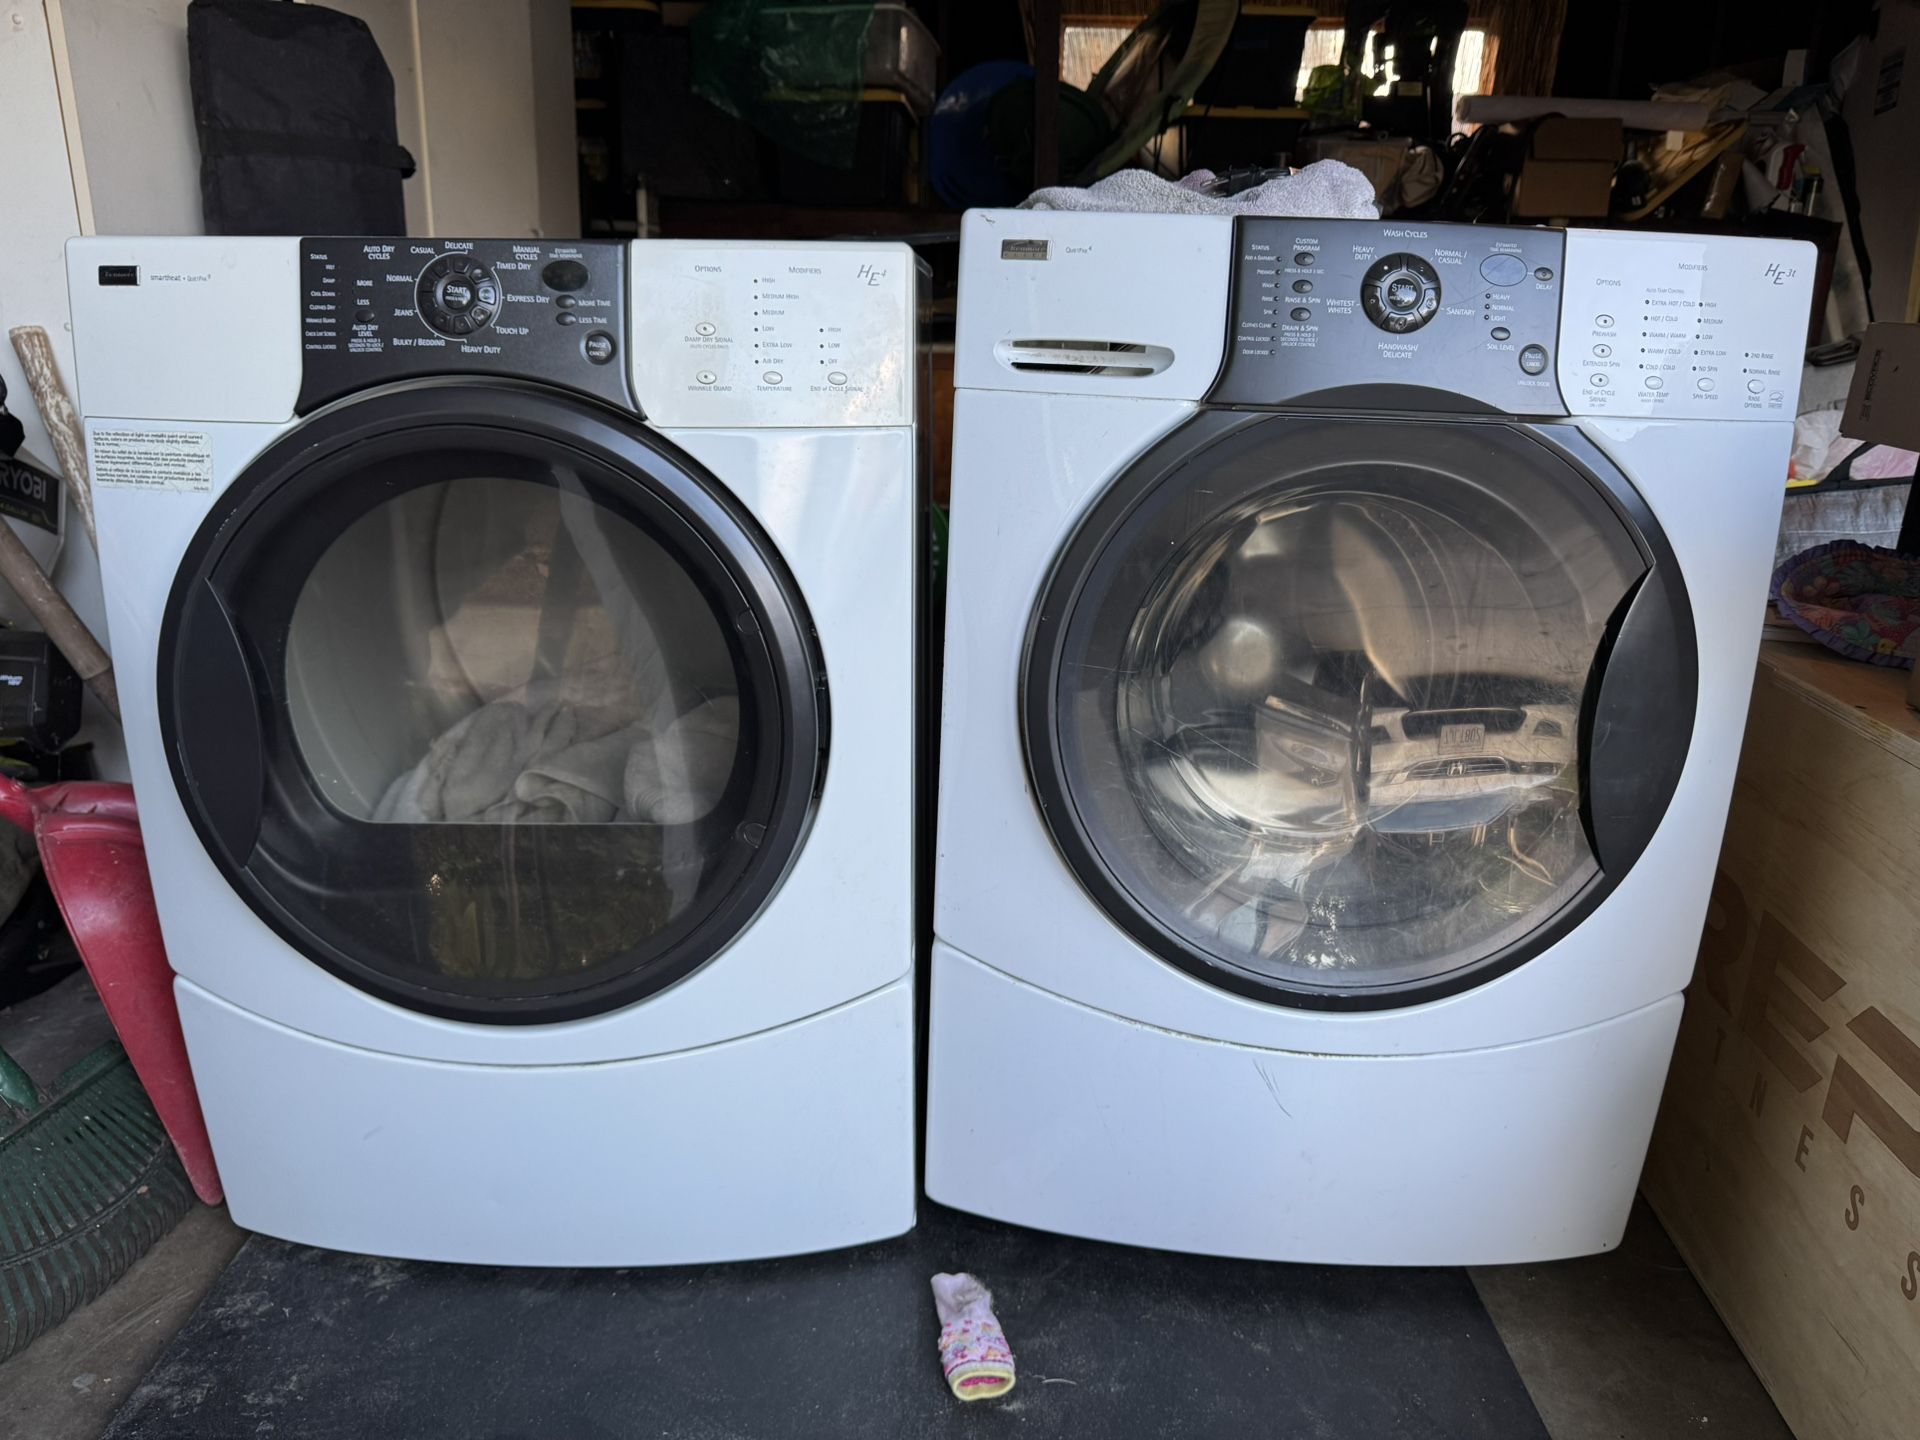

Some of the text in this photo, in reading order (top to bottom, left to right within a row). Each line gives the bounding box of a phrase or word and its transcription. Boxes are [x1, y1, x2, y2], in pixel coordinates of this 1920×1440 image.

[1384, 229, 1404, 238] WASH
[363, 245, 395, 253] AUTO DRY
[445, 241, 474, 250] DELICATE
[1353, 245, 1375, 253] HEAVY
[411, 247, 435, 255] CASUAL
[1435, 249, 1462, 258] NORMAL
[1439, 257, 1463, 265] CASUAL
[518, 262, 532, 271] DRY
[695, 264, 722, 274] OPTIONS
[789, 266, 822, 275] MODIFIERS
[1678, 263, 1708, 271] MODIFIERS
[1596, 278, 1621, 287] OPTIONS
[446, 285, 467, 294] START
[507, 295, 550, 304] EXPRESS DRY
[1327, 299, 1355, 307] WHITEST
[394, 309, 414, 317] JEANS
[1447, 307, 1476, 316] SANITARY
[496, 326, 518, 335] TOUCH
[393, 338, 412, 346] BULKY
[418, 338, 445, 346] BEDDING
[702, 336, 713, 344] DRY
[461, 345, 501, 354] HEAVY DUTY
[589, 341, 607, 349] PAUSE
[1378, 342, 1419, 353] HANDWASH/
[1500, 344, 1515, 352] LEVEL
[1383, 350, 1413, 359] DELICATE
[1583, 360, 1608, 368] EXTENDED
[829, 385, 844, 393] CYCLE
[845, 385, 864, 393] SIGNAL
[0, 462, 47, 502] RYOBI
